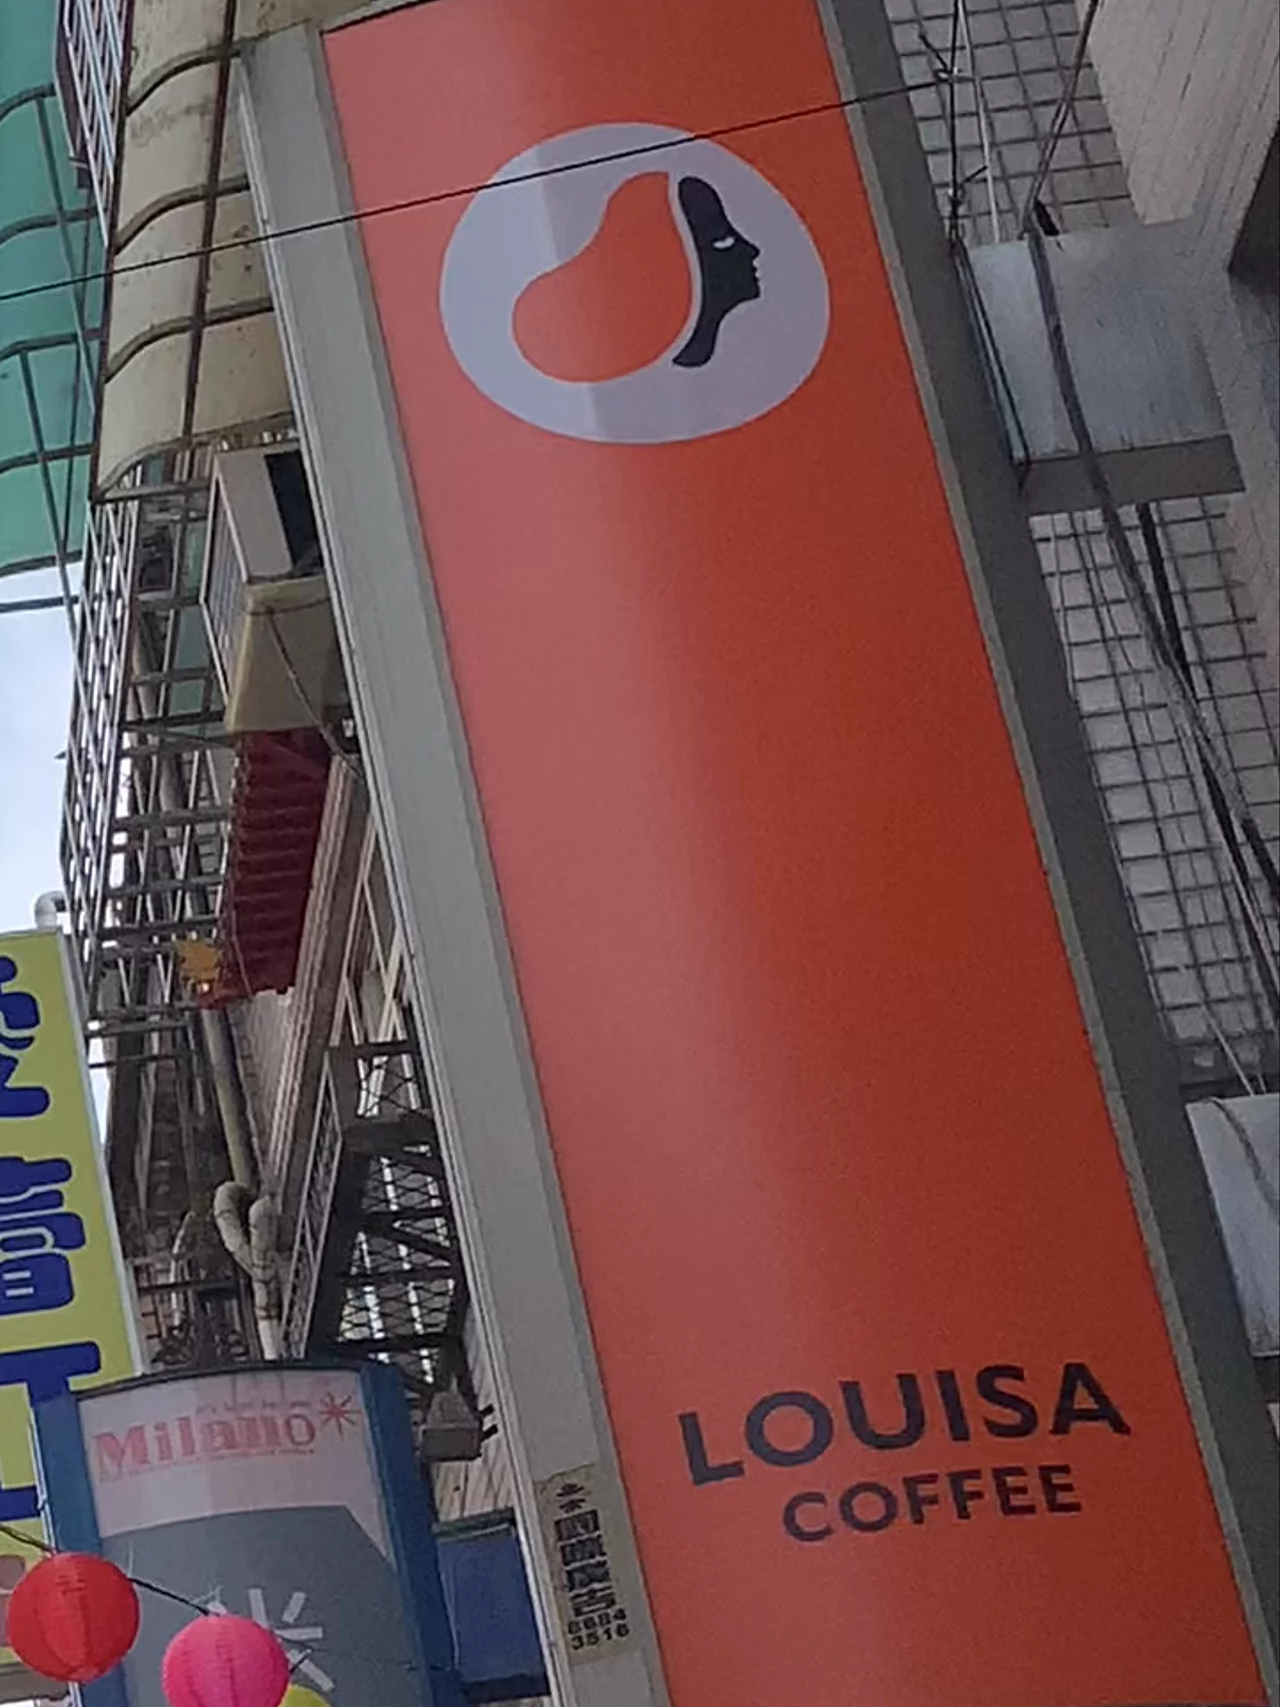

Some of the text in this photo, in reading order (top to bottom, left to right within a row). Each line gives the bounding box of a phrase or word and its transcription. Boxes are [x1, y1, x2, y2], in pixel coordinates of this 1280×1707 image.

[93, 1413, 316, 1483] Milano
[678, 1360, 1132, 1487] LOUISA
[782, 1463, 1083, 1543] COFFEE
